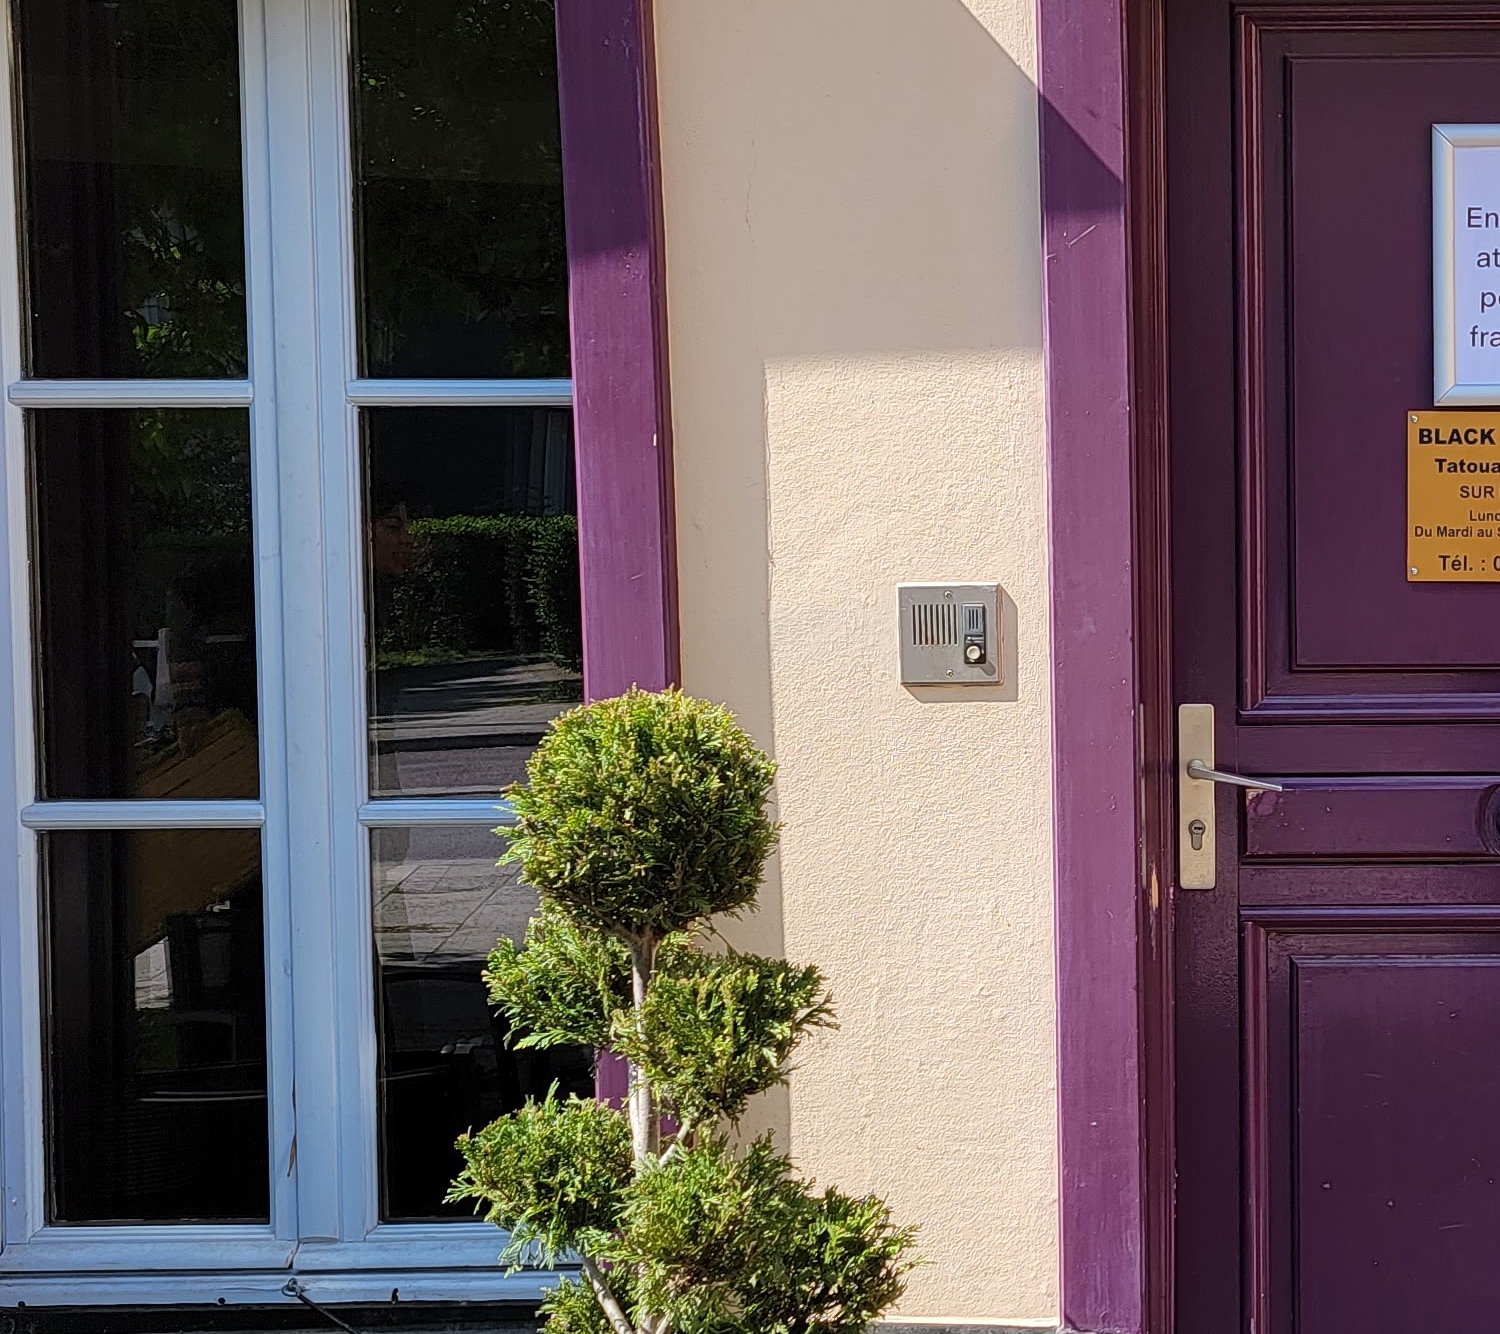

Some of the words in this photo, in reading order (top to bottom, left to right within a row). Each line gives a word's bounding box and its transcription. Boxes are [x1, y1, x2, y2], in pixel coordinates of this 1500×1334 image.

[1468, 207, 1498, 228] En
[1419, 428, 1496, 445] BLACK
[1460, 486, 1494, 499] SUR
[1415, 526, 1432, 537] Du
[1437, 526, 1472, 537] Mardi
[1477, 529, 1492, 537] au
[1438, 555, 1473, 571] Tél.
